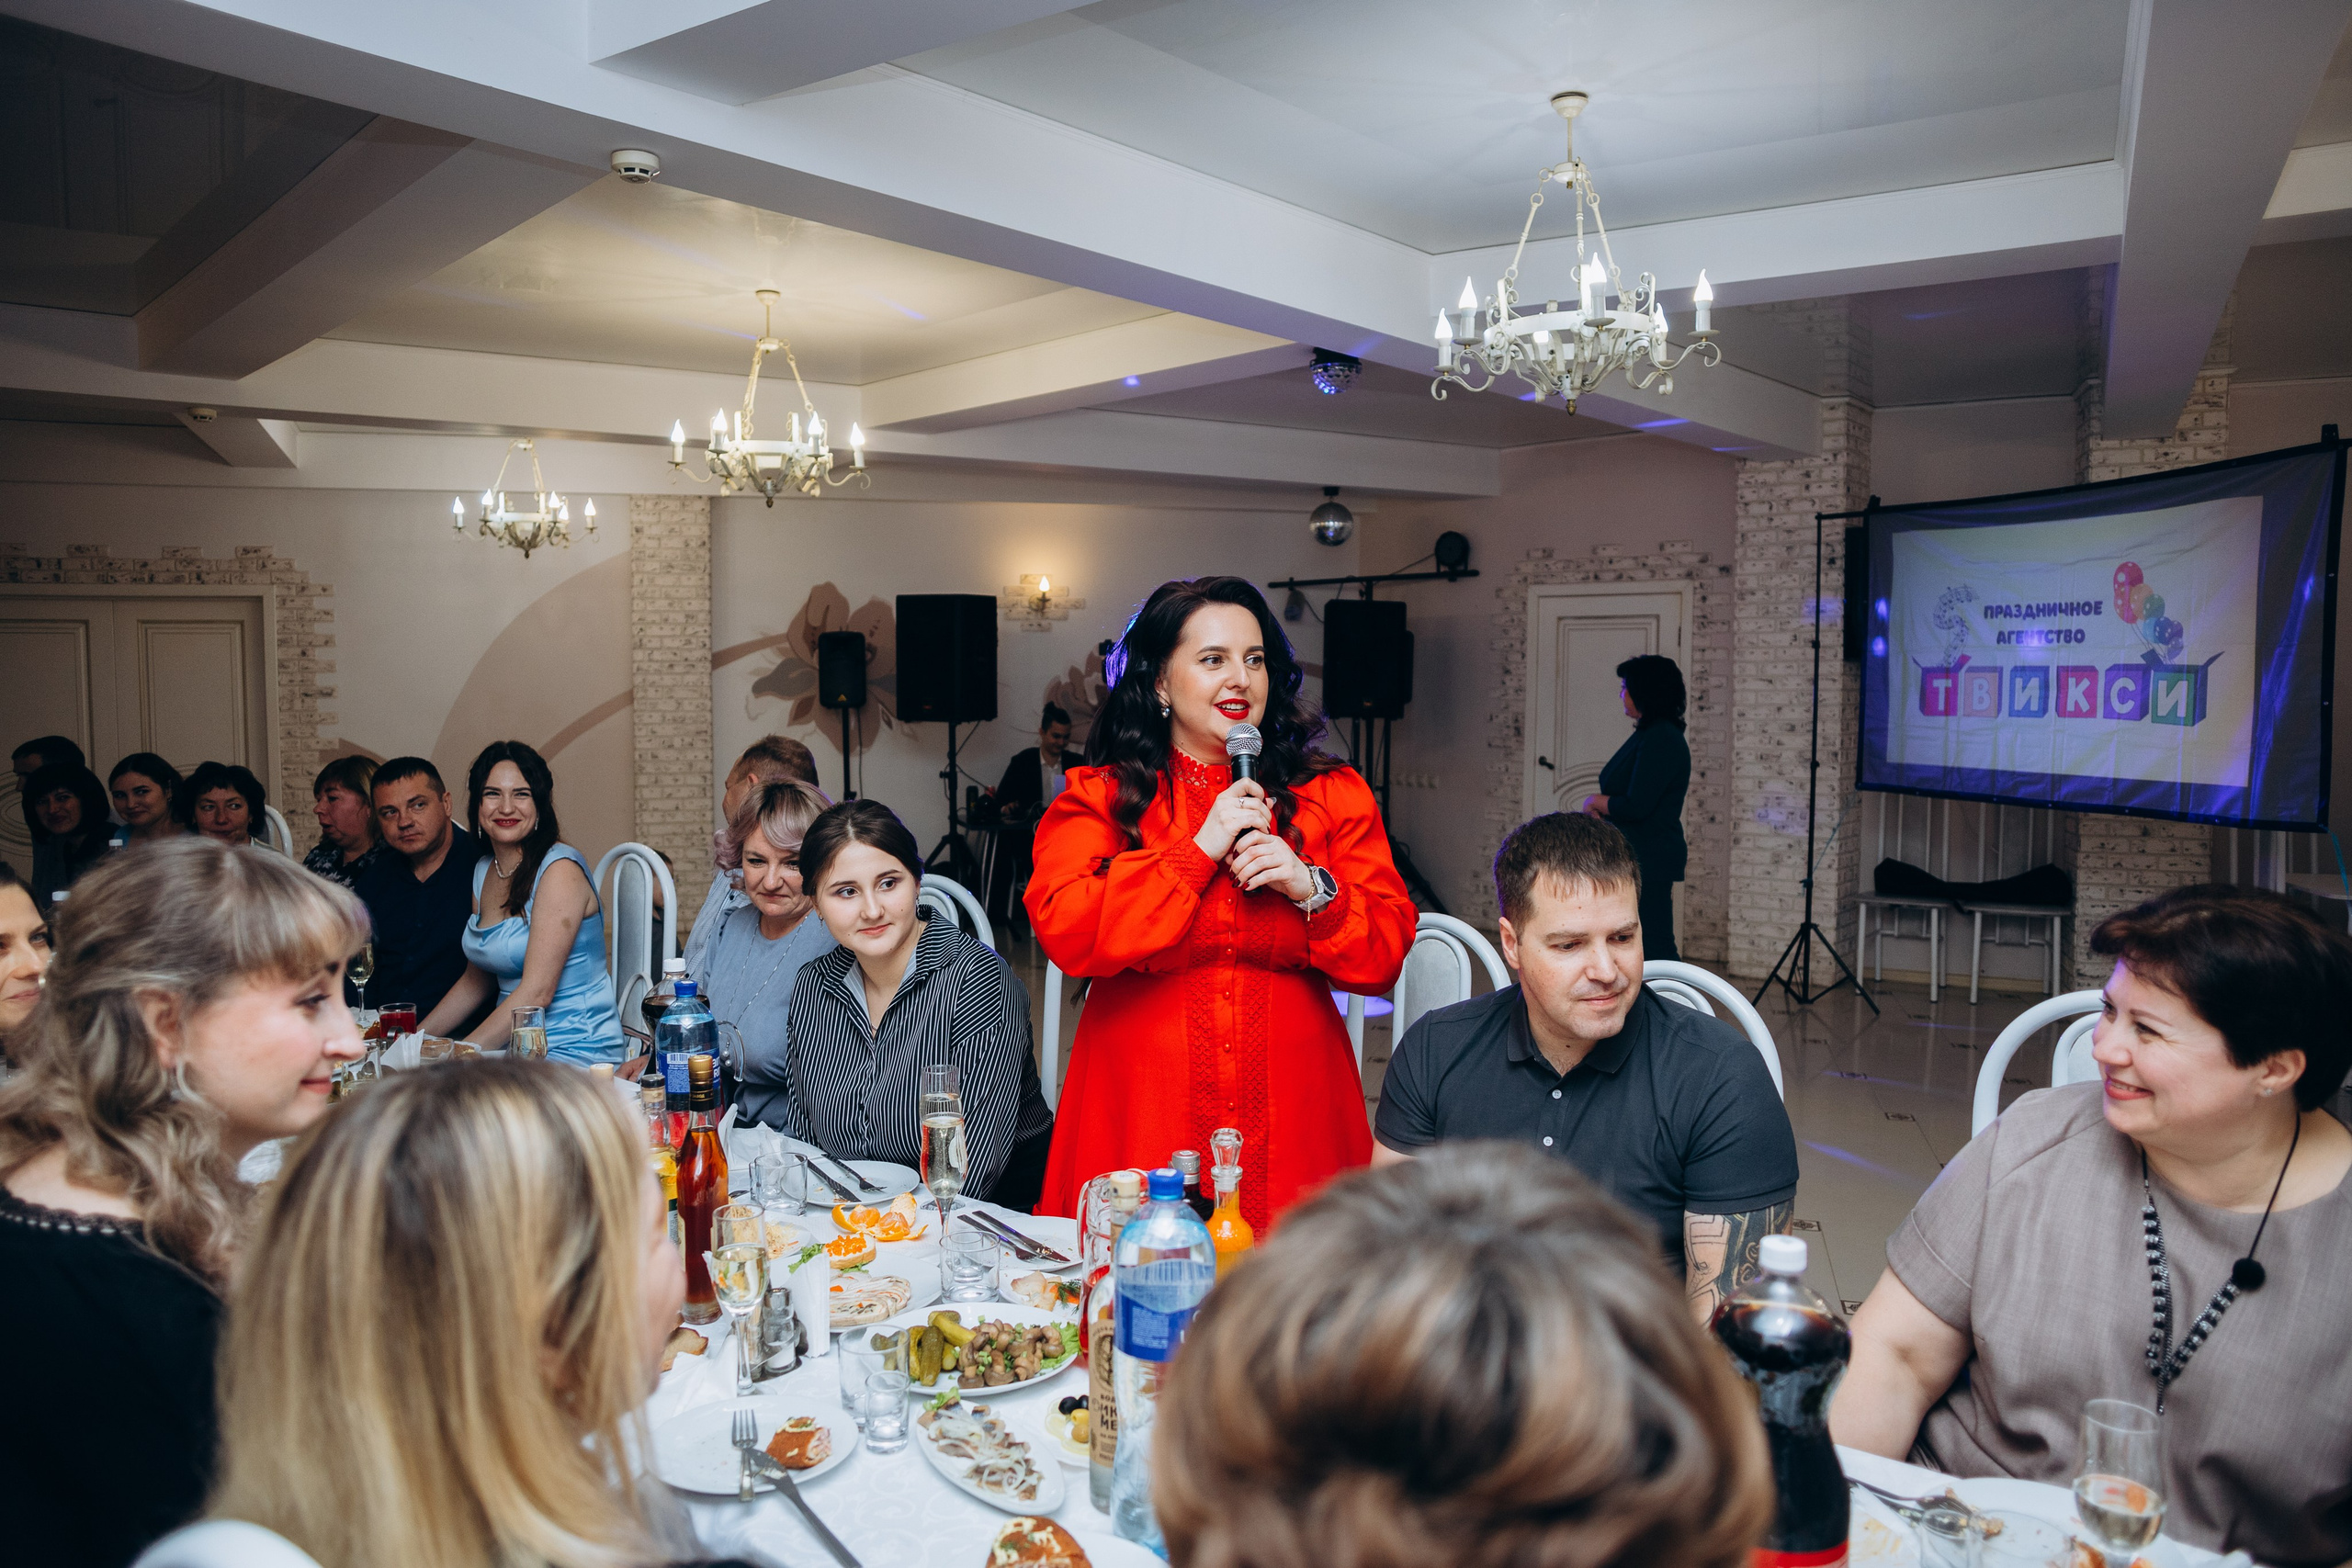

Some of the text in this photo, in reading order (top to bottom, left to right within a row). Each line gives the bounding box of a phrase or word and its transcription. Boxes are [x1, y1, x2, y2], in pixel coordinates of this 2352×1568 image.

[1984, 600, 2104, 621] ПРАЗДНИЧНОЕ
[1996, 628, 2086, 645] АГЕНТСТВО
[1932, 676, 2188, 717] ТВИКСИ
